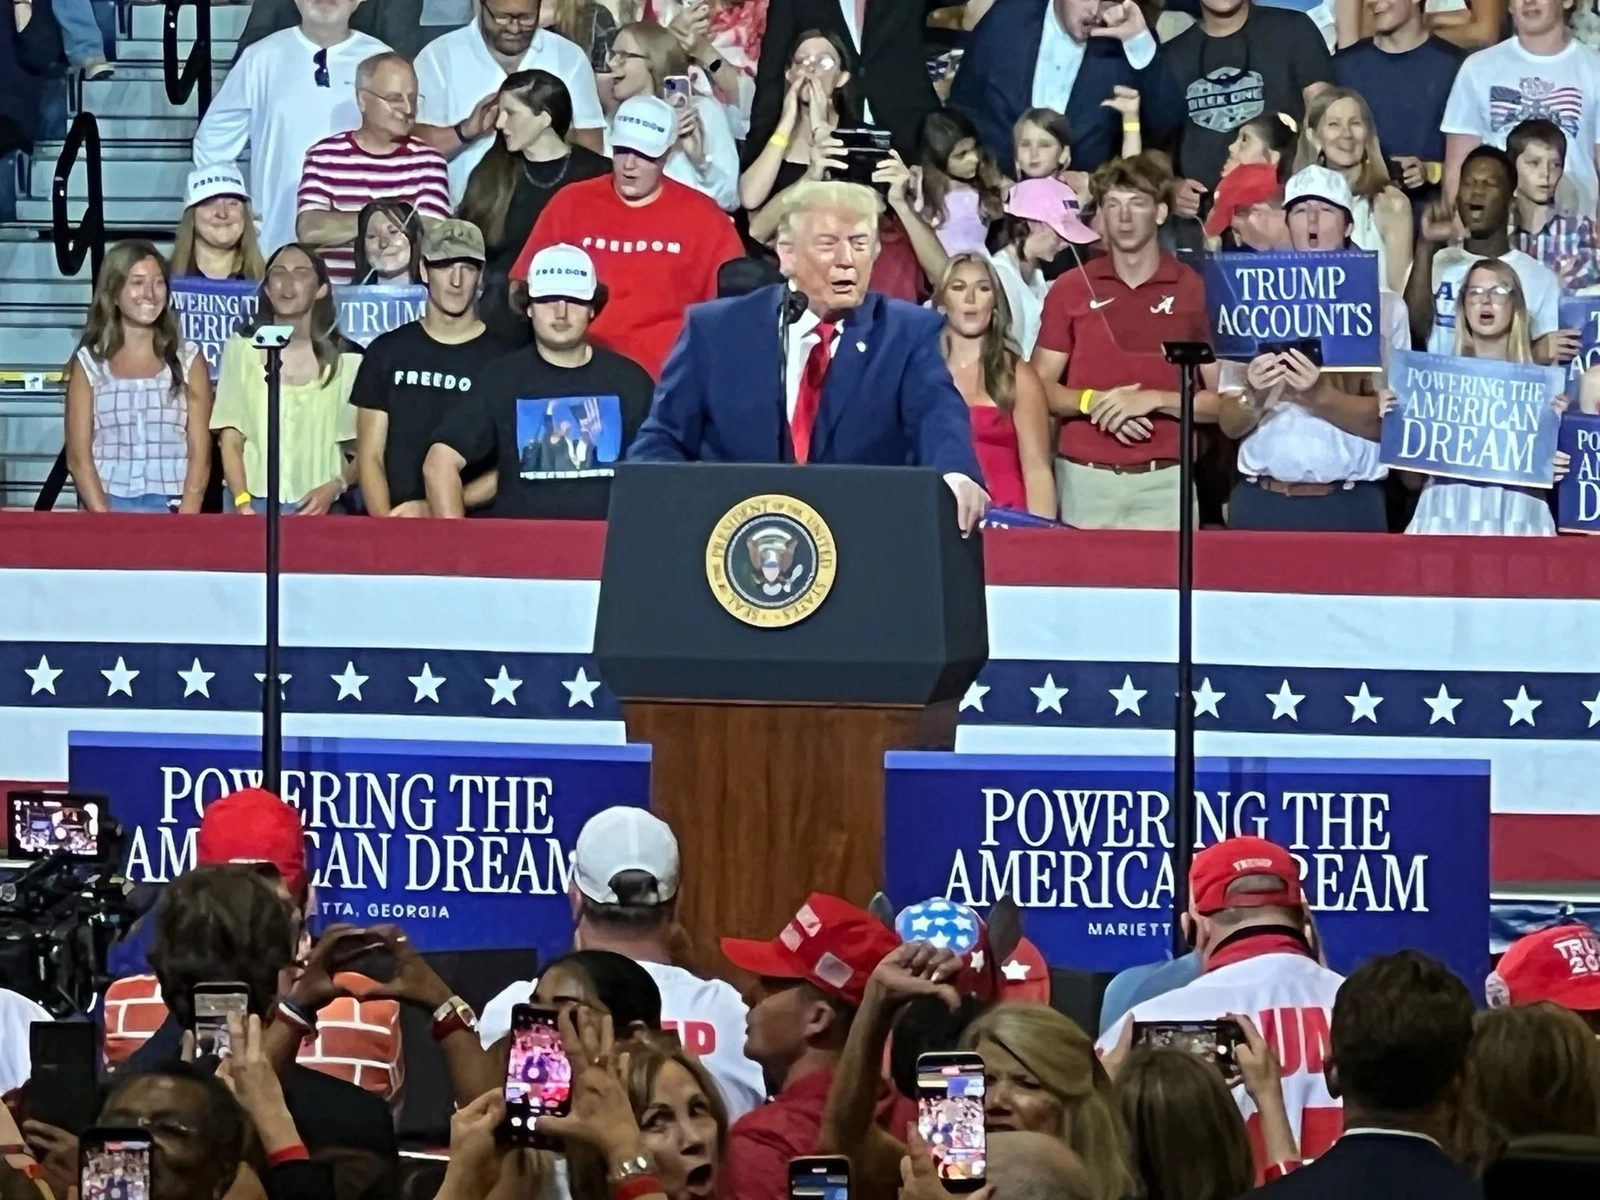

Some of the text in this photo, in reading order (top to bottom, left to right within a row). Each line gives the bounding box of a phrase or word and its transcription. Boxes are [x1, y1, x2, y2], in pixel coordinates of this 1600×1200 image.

[1235, 266, 1346, 301] TRUMP
[341, 300, 427, 333] TRUM
[1216, 303, 1374, 338] ACCOUNTS
[1407, 367, 1546, 403] POWERING THE
[1404, 390, 1543, 432] AMERICAN
[1397, 417, 1539, 474] DREAM
[449, 774, 554, 834] THE
[981, 788, 1390, 850] POWERNG THE
[945, 848, 1175, 909] AMERICA
[366, 902, 450, 919] GEORGIA
